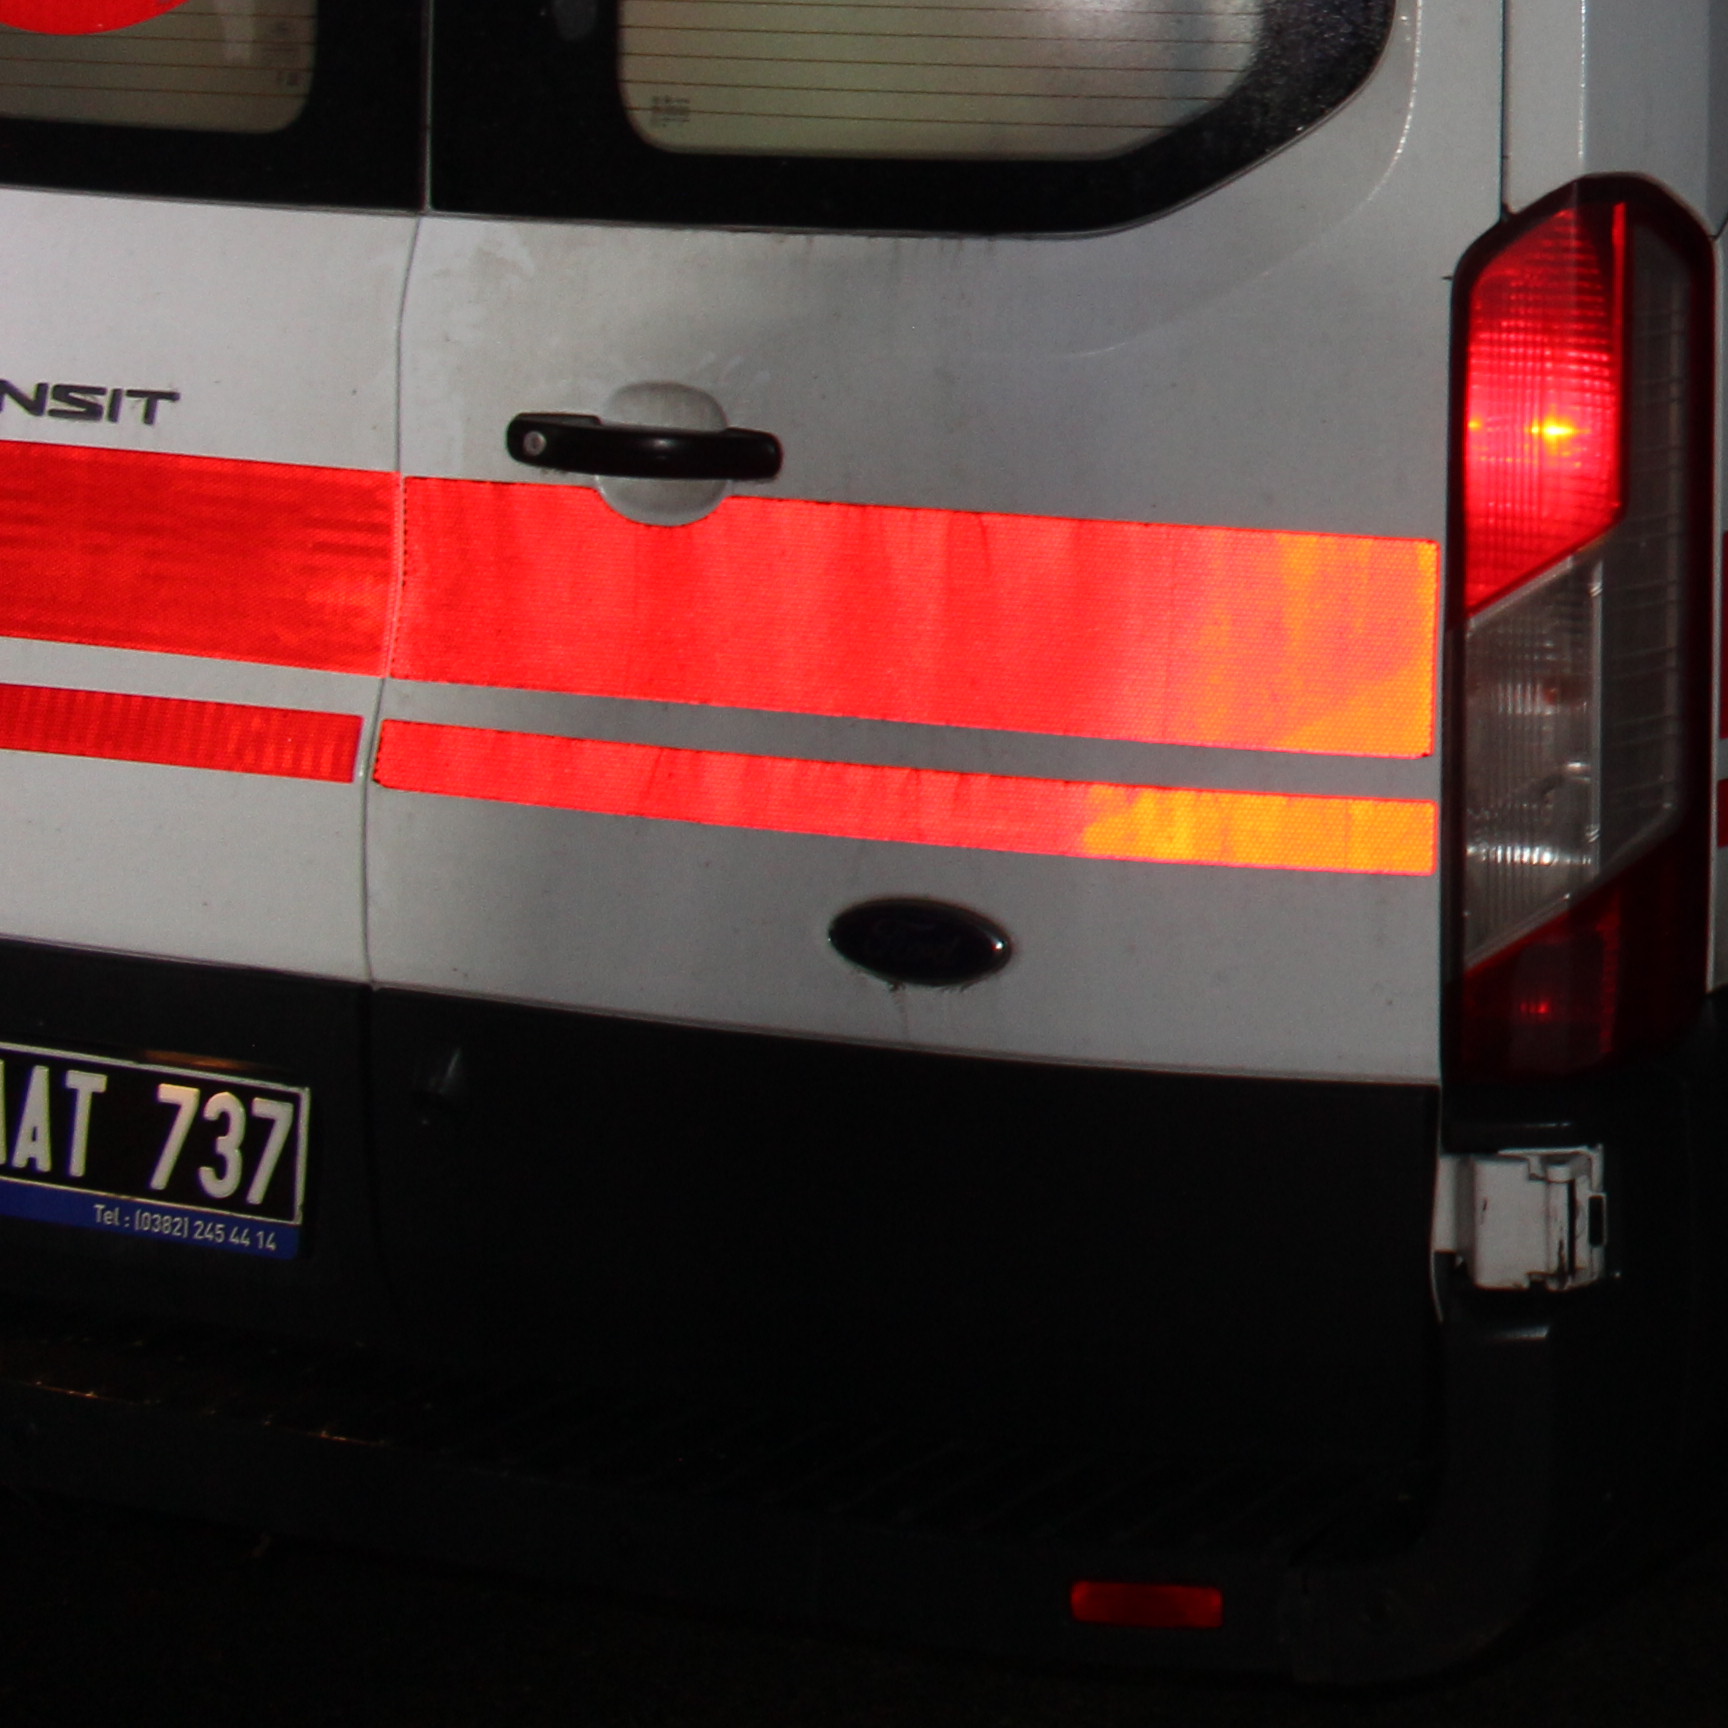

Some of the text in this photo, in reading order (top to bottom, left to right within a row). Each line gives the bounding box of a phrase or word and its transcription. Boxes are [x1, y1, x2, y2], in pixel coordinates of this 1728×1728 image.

[0, 1059, 294, 1205] AT 737
[133, 1208, 190, 1239] (0382)
[193, 1220, 226, 1243] 245
[228, 1226, 251, 1247] 44
[256, 1230, 277, 1251] 14
